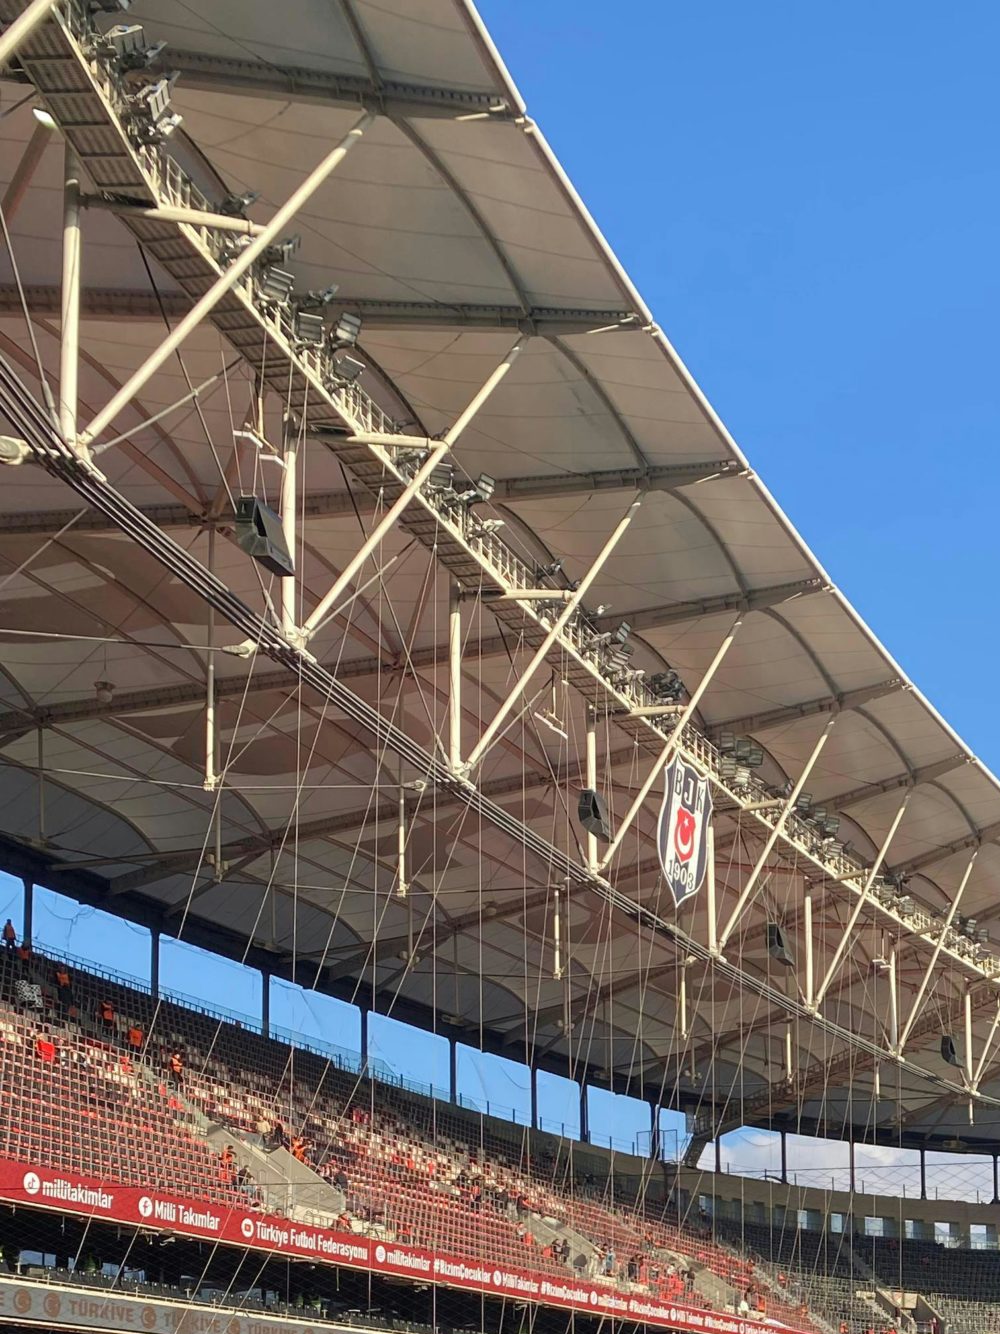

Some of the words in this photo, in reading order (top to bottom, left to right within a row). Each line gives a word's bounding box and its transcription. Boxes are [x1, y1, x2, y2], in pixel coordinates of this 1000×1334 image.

[674, 770, 705, 815] BJK
[667, 859, 694, 890] 1903
[154, 1199, 176, 1223] Milli
[178, 1203, 220, 1231] Takımlar
[255, 1220, 289, 1248] Türkiye
[290, 1229, 316, 1251] Futbol
[317, 1234, 368, 1261] Federasyonu
[69, 1298, 134, 1323] TÜRKİYE
